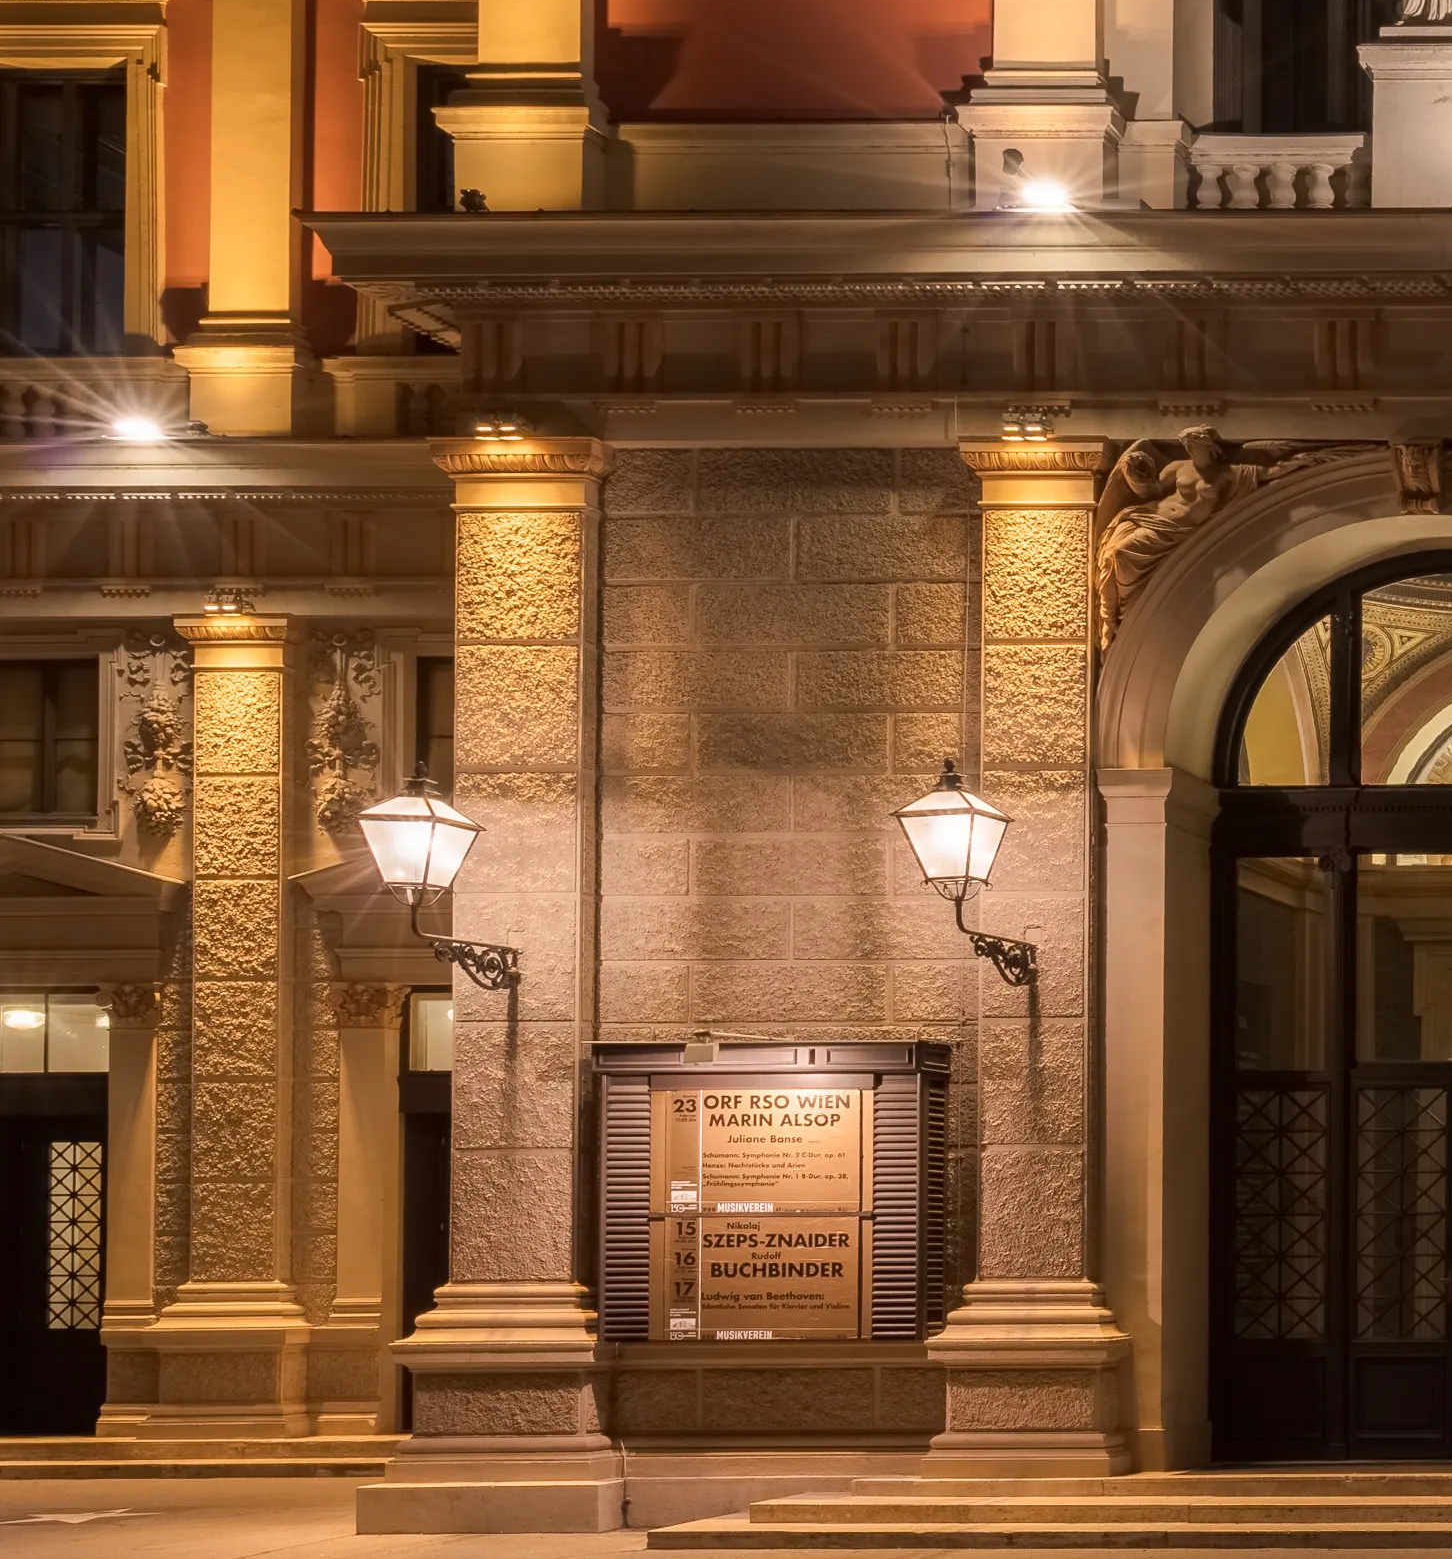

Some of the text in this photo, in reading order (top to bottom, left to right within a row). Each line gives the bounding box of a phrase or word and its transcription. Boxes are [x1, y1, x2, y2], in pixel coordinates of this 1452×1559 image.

[673, 1099, 696, 1113] 23
[703, 1095, 850, 1109] ORF RSO WIEN
[709, 1113, 841, 1127] MARIN ALSOP
[727, 1135, 803, 1144] Juliane Banse
[716, 1203, 773, 1212] MUSIKVEREIN
[676, 1222, 696, 1236] 15
[727, 1222, 760, 1231] Nikolaj
[702, 1233, 850, 1248] SZEPS-ZNAIDER
[675, 1252, 696, 1265] 16
[752, 1252, 781, 1260] Rudolf
[711, 1262, 843, 1278] BUCHBINDER
[674, 1282, 695, 1295] 17
[701, 1292, 740, 1302] Ludwig
[767, 1291, 825, 1300] Beethoven:
[716, 1330, 773, 1340] MUSIKVEREIN
